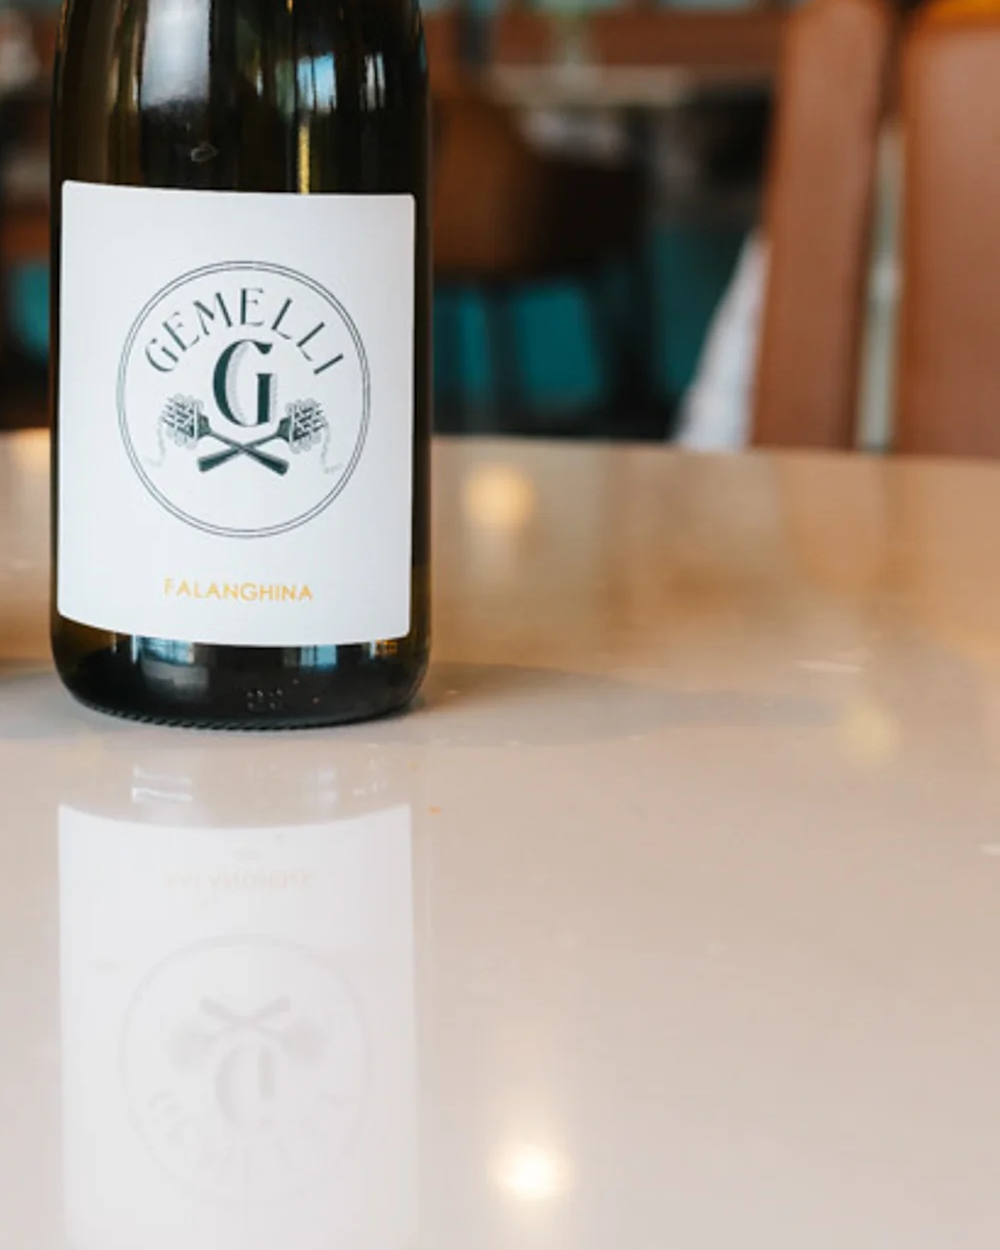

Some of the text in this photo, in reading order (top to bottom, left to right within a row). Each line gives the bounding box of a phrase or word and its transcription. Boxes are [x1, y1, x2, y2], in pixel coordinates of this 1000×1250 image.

[145, 288, 344, 373] GEMELLI
[213, 339, 278, 427] G
[164, 578, 313, 602] FALANGHINA
